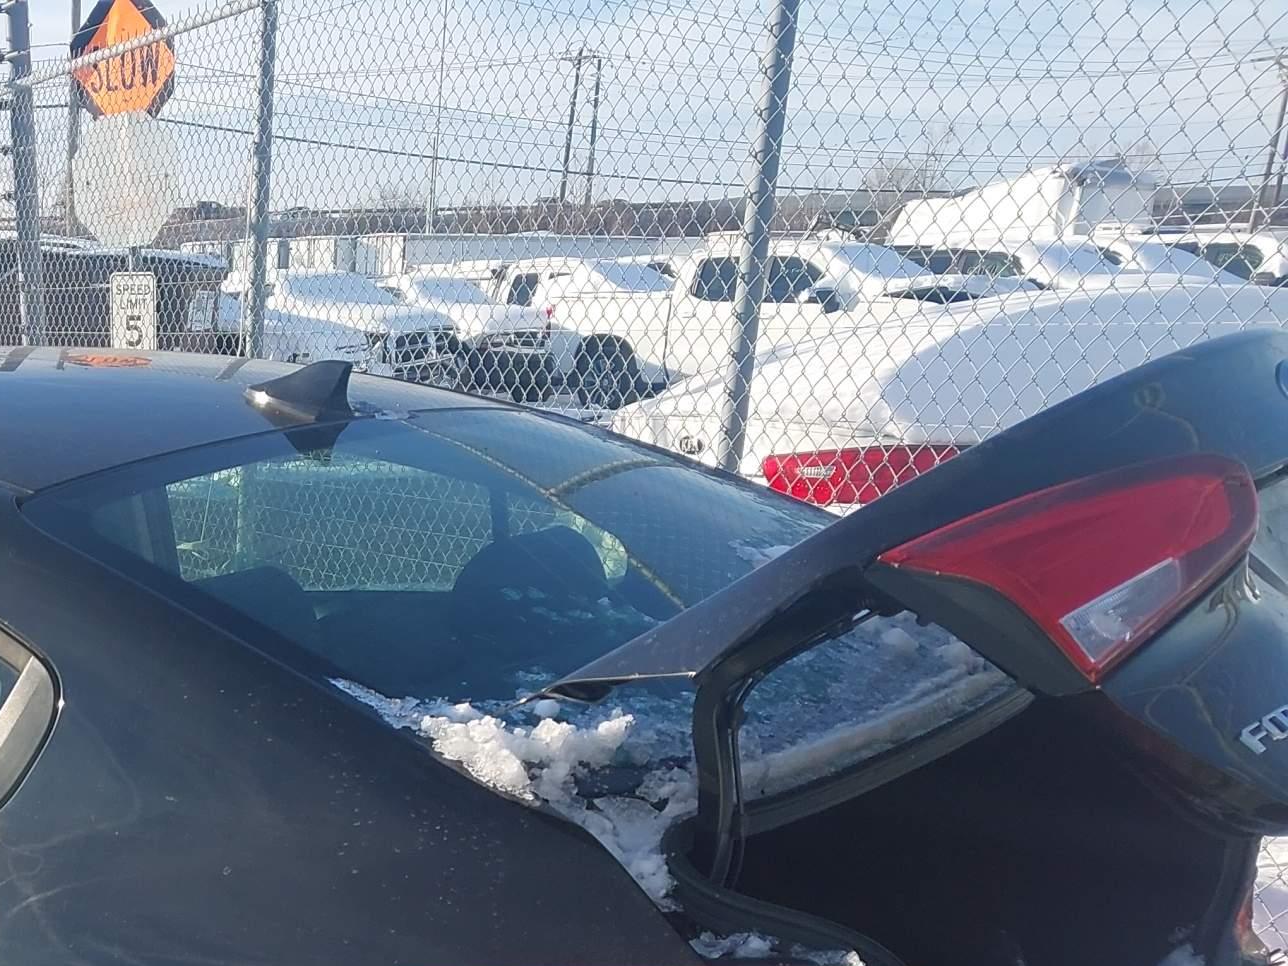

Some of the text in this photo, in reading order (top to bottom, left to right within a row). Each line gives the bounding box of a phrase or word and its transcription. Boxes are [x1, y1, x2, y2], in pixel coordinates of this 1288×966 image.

[91, 43, 161, 93] SLOW
[115, 283, 151, 296] SPEED
[120, 298, 148, 309] LIMIT
[125, 314, 143, 347] 5
